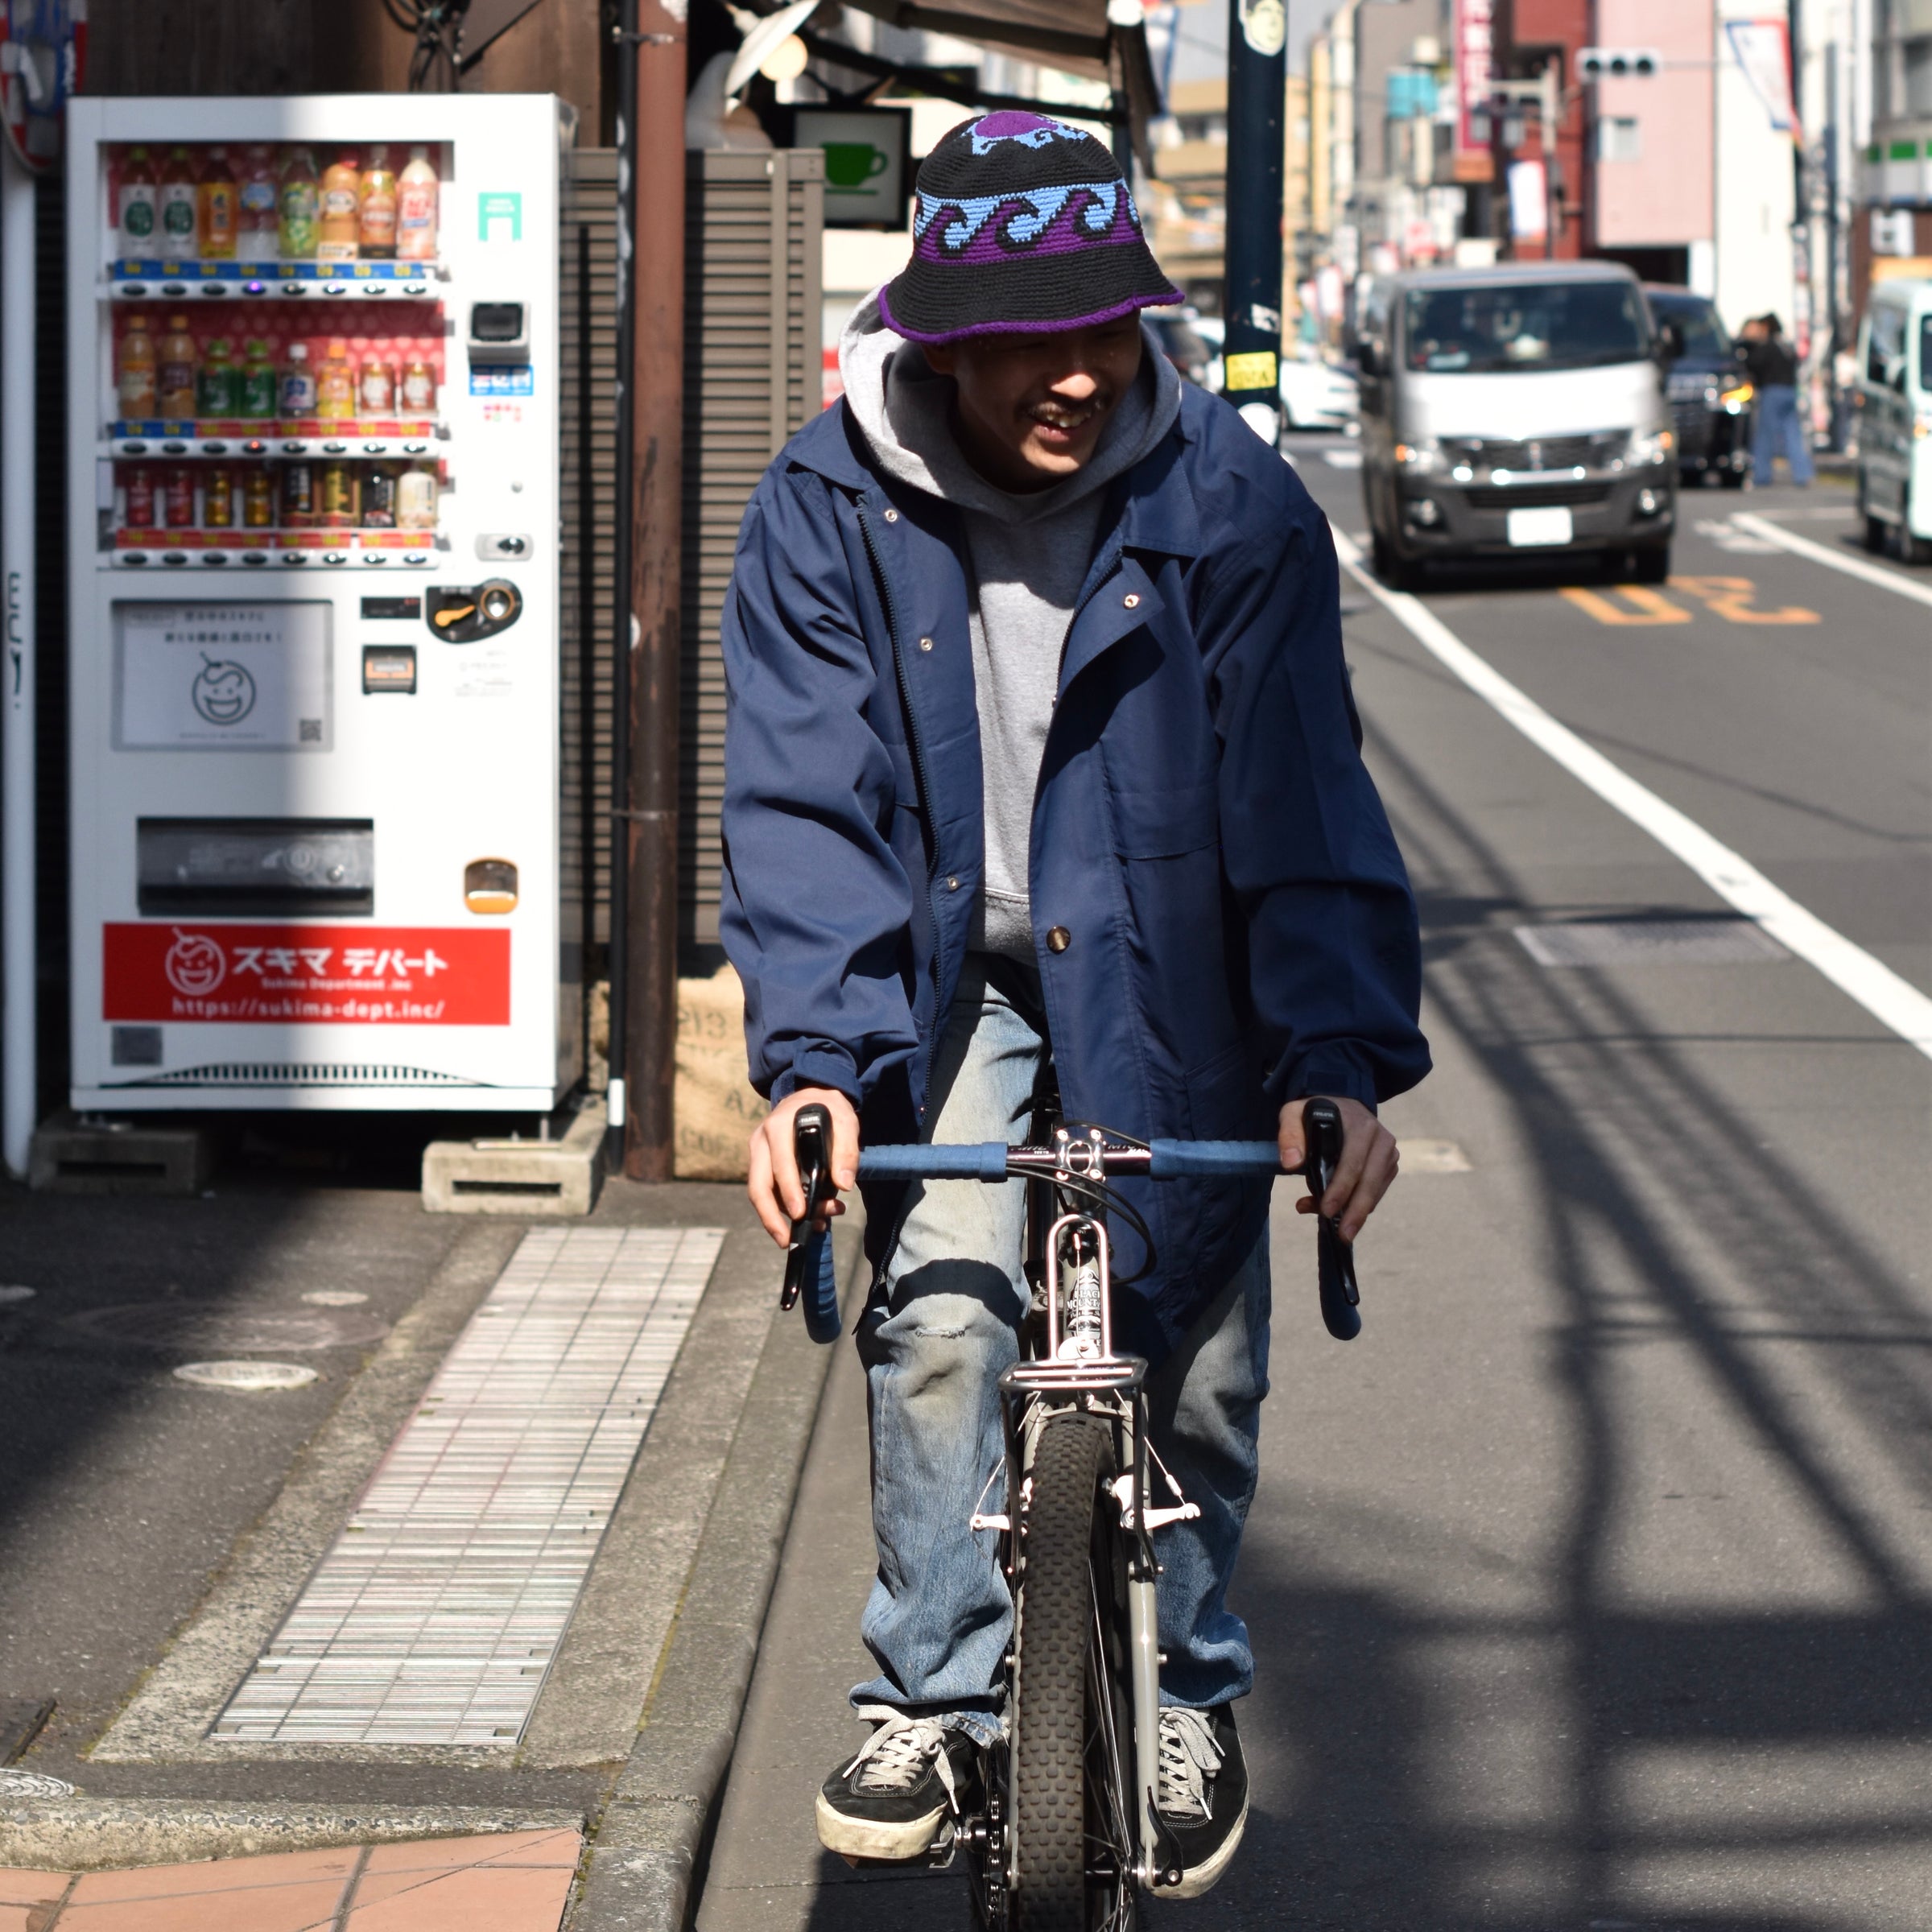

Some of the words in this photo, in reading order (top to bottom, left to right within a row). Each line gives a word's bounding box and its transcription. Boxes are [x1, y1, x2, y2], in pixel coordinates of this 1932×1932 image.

[233, 947, 332, 976] スキマ
[342, 947, 448, 977] デパート
[171, 996, 445, 1021] https://sukima-dept.inc/
